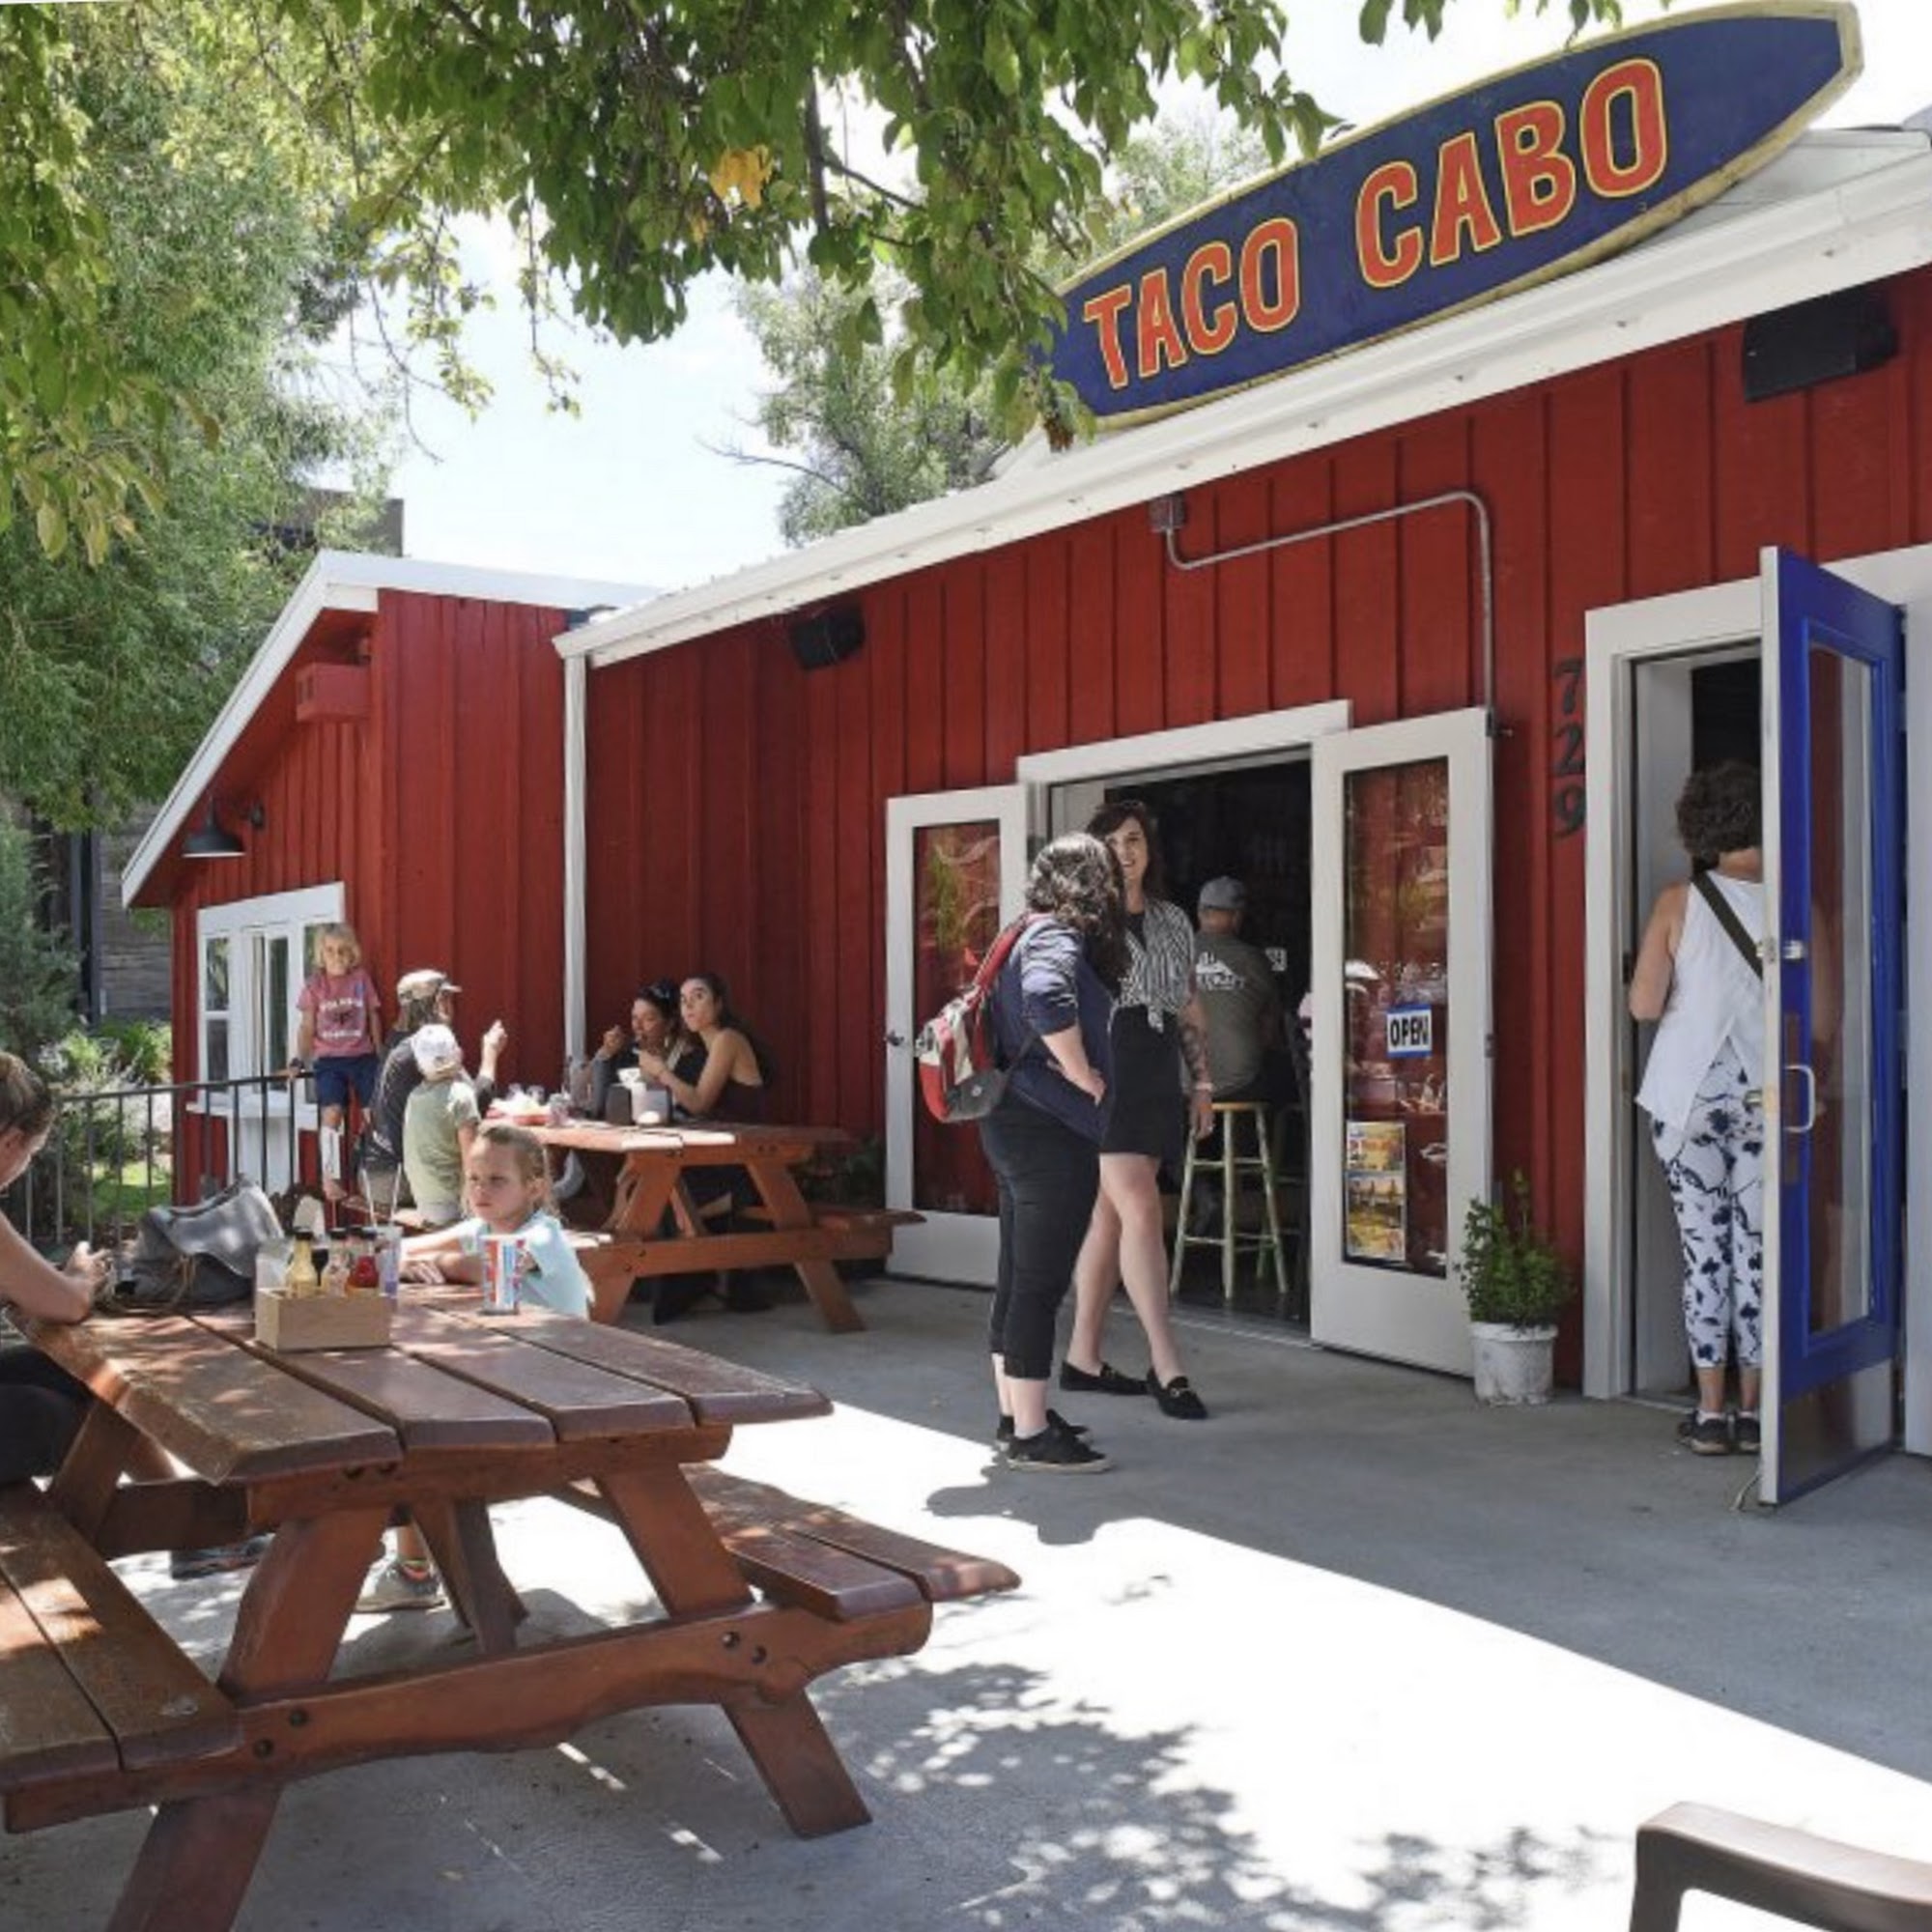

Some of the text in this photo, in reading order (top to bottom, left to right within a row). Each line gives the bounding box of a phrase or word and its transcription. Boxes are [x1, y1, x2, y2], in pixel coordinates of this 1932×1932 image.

[1083, 56, 1668, 389] TACO CABO
[1551, 658, 1586, 841] 729
[1390, 1015, 1430, 1047] OPEN
